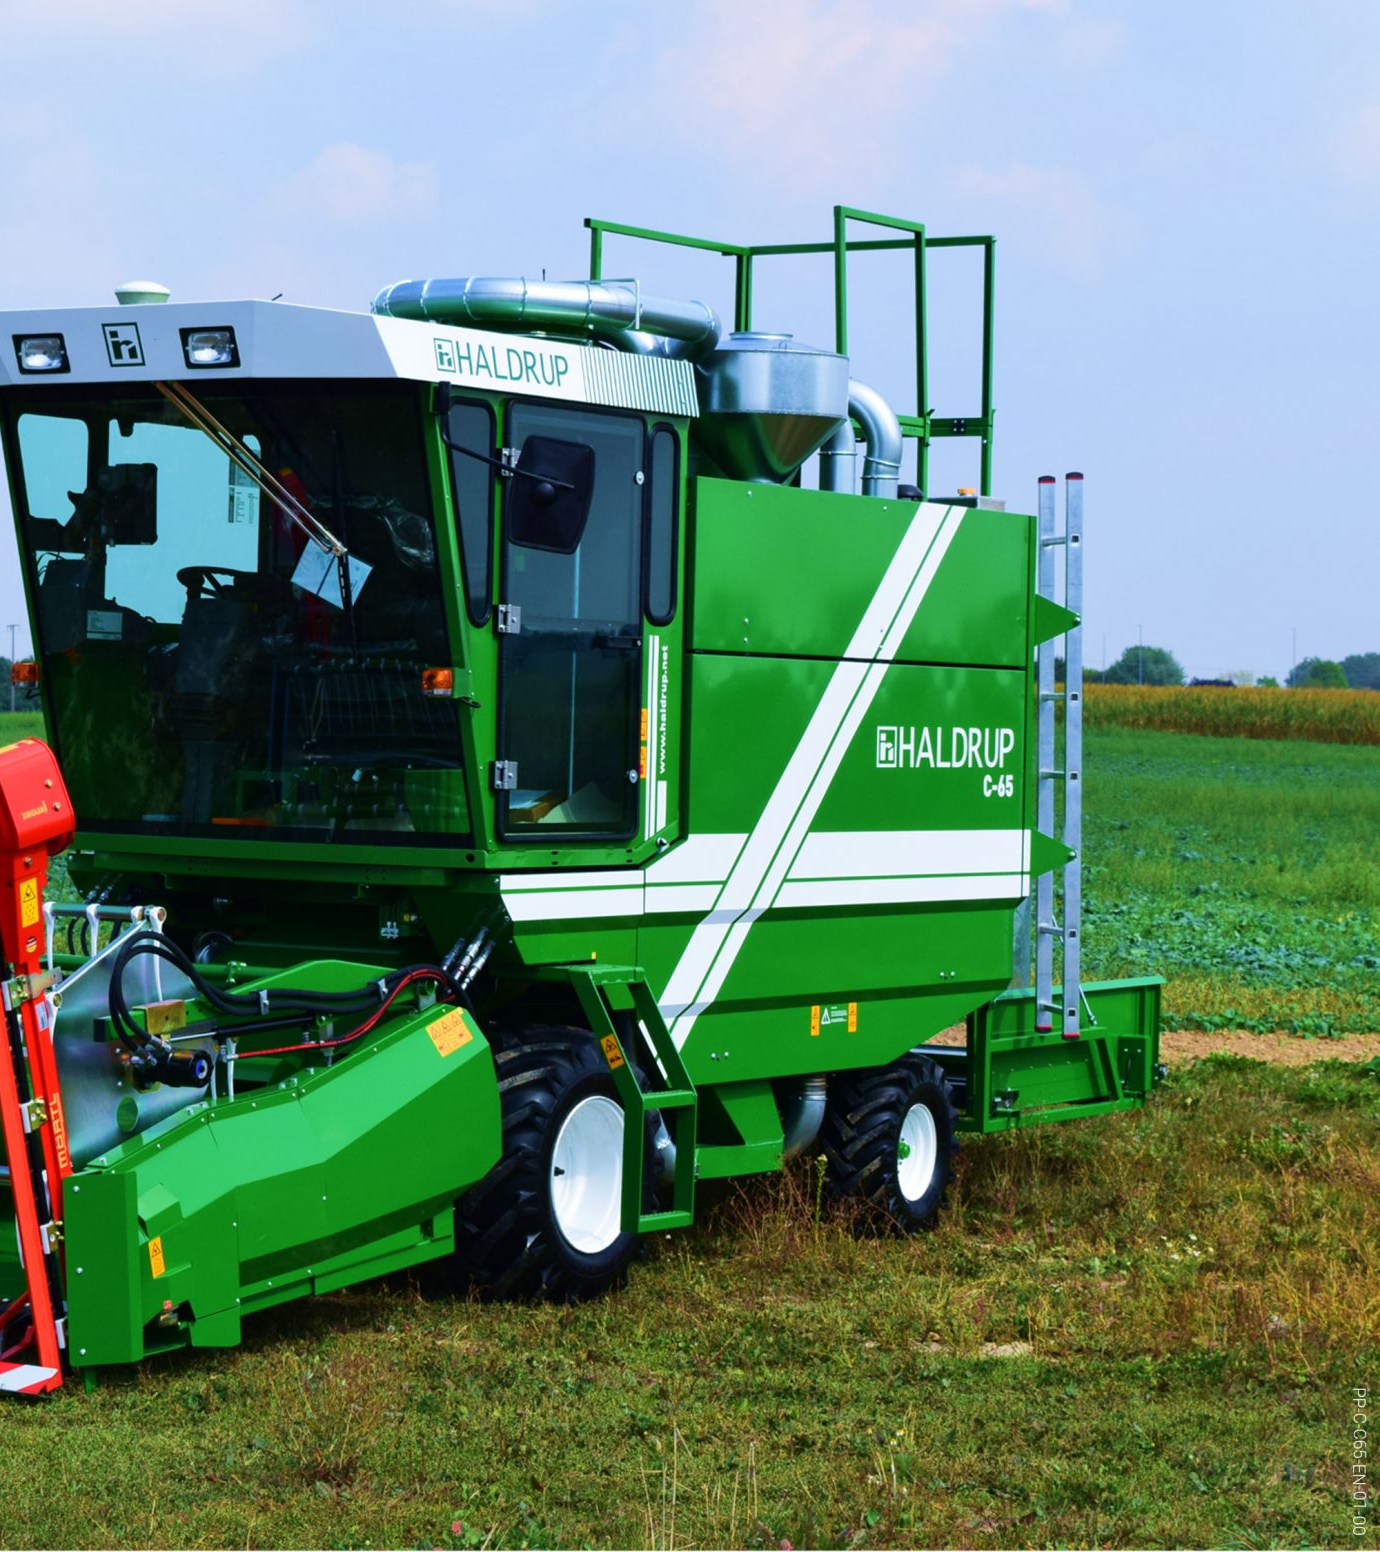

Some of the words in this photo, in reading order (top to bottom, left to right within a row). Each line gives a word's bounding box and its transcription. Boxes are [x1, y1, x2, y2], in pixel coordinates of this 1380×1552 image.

[455, 340, 569, 387] HALDRUP
[659, 644, 669, 775] www.haldrup.net
[898, 725, 1015, 769] HALDRUP
[982, 773, 1015, 798] C-65
